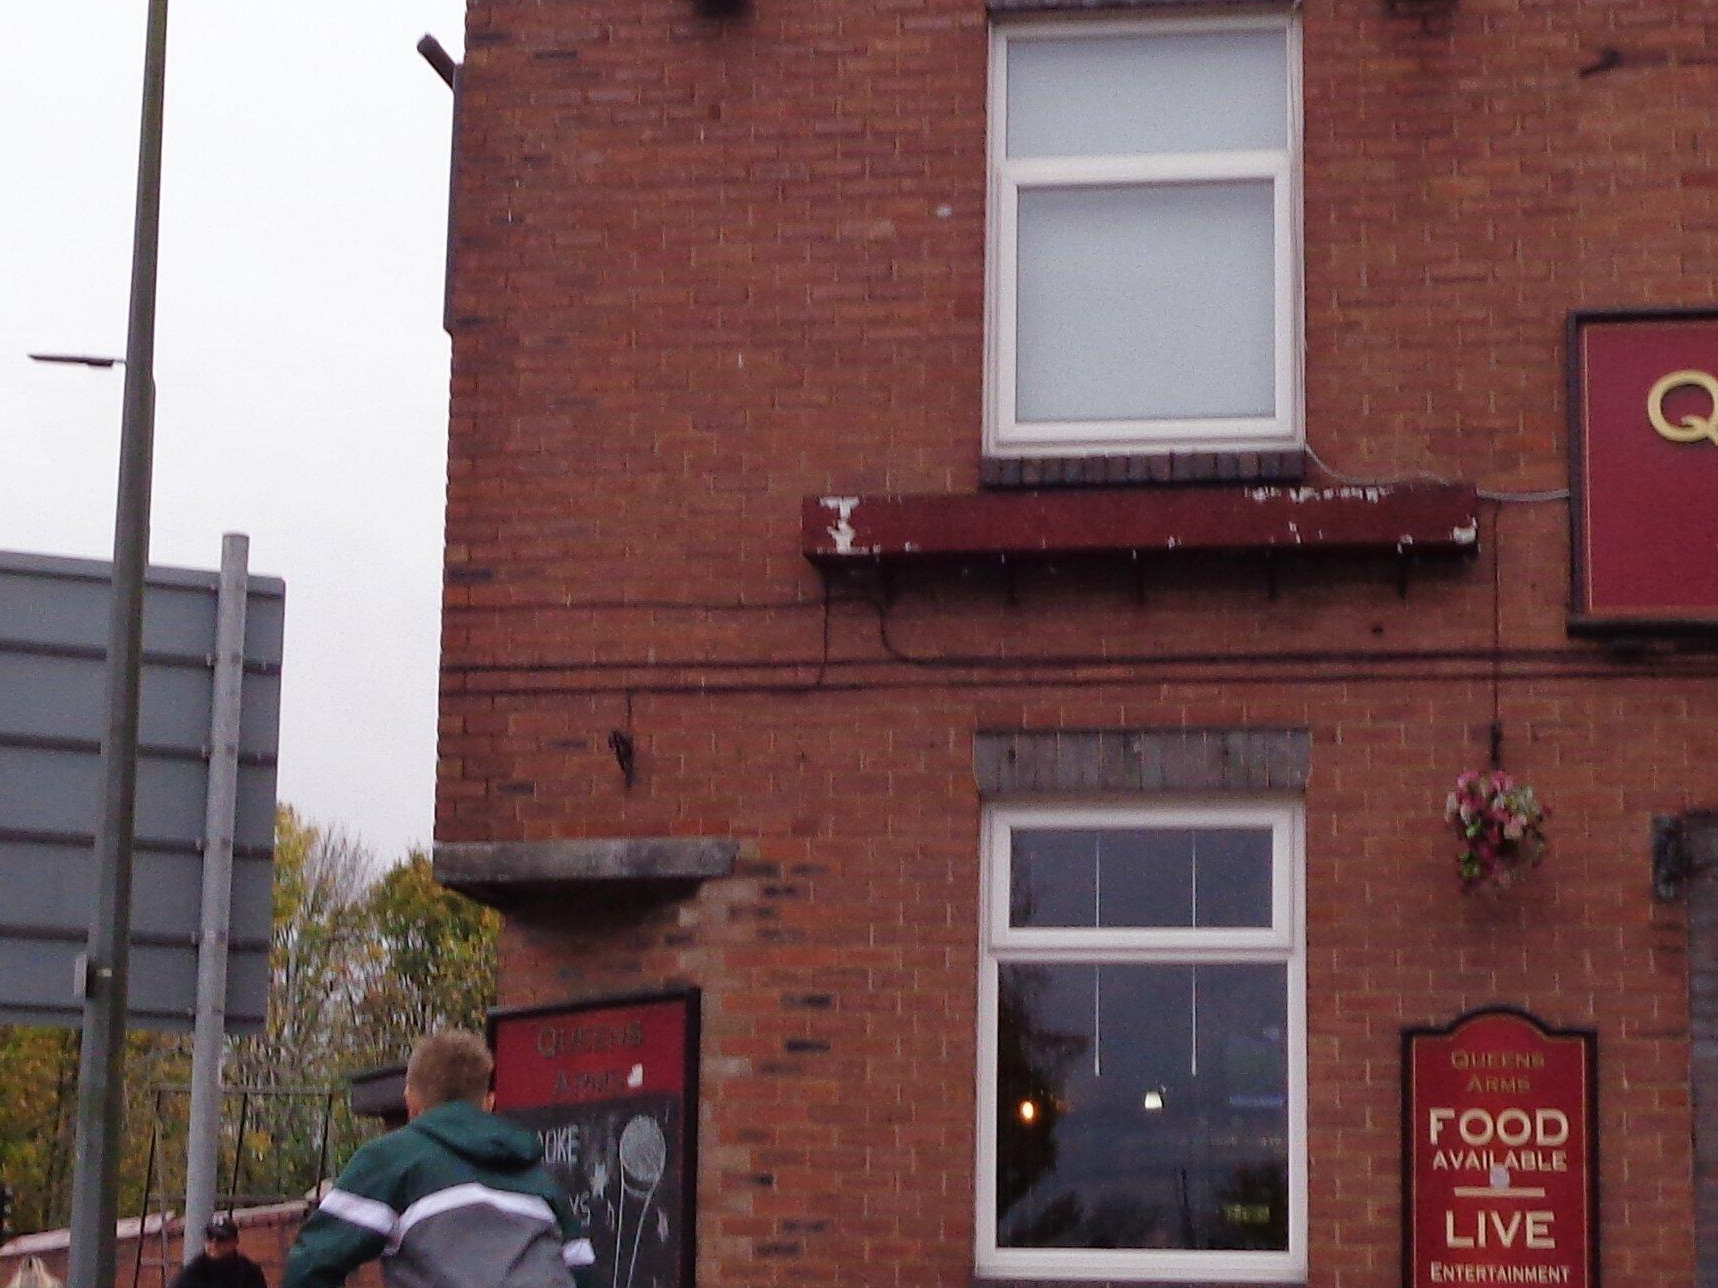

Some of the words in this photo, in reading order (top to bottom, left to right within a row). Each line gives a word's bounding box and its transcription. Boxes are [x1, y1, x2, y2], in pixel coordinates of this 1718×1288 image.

[1451, 1049, 1545, 1070] QUEENS
[1466, 1076, 1531, 1093] ARMS
[1429, 1107, 1570, 1147] FOOD
[1433, 1150, 1569, 1172] AVAILABLE
[1445, 1210, 1556, 1249] LIVE
[1430, 1261, 1571, 1285] ENTERTAINMENT
